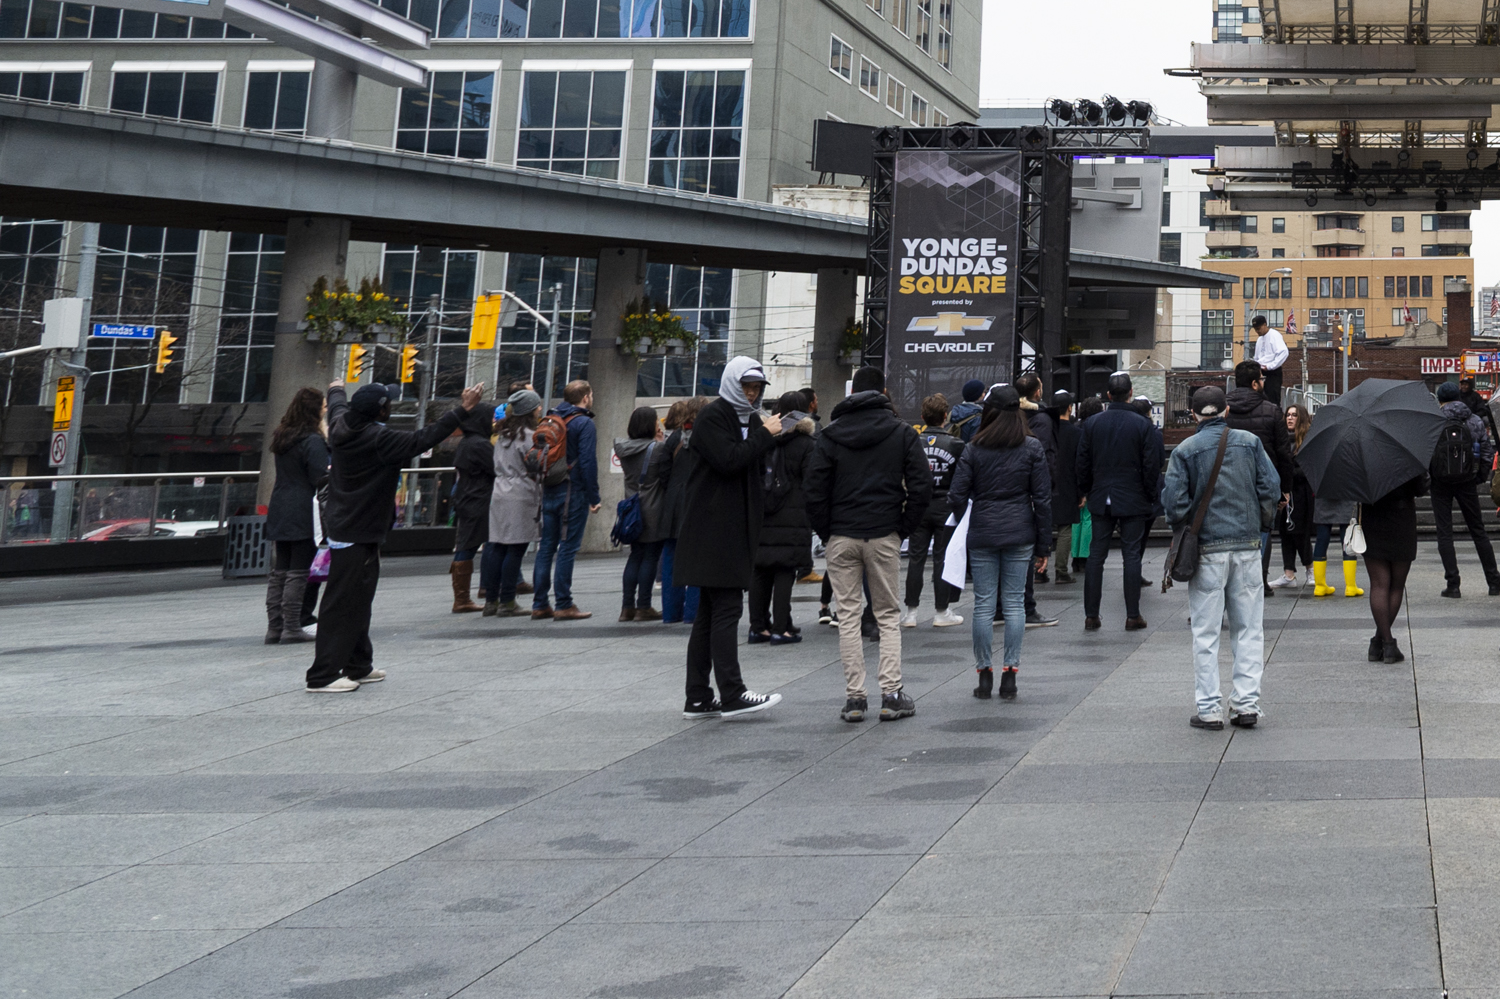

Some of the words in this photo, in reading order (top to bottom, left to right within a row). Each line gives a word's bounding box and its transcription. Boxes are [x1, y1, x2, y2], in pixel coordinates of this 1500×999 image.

[902, 238, 1007, 257] YONGE-
[901, 257, 1007, 275] DUNDAS
[899, 276, 1006, 294] SQUARE
[101, 325, 134, 335] Dundas
[142, 327, 148, 336] E
[904, 343, 995, 353] CHEVROLET
